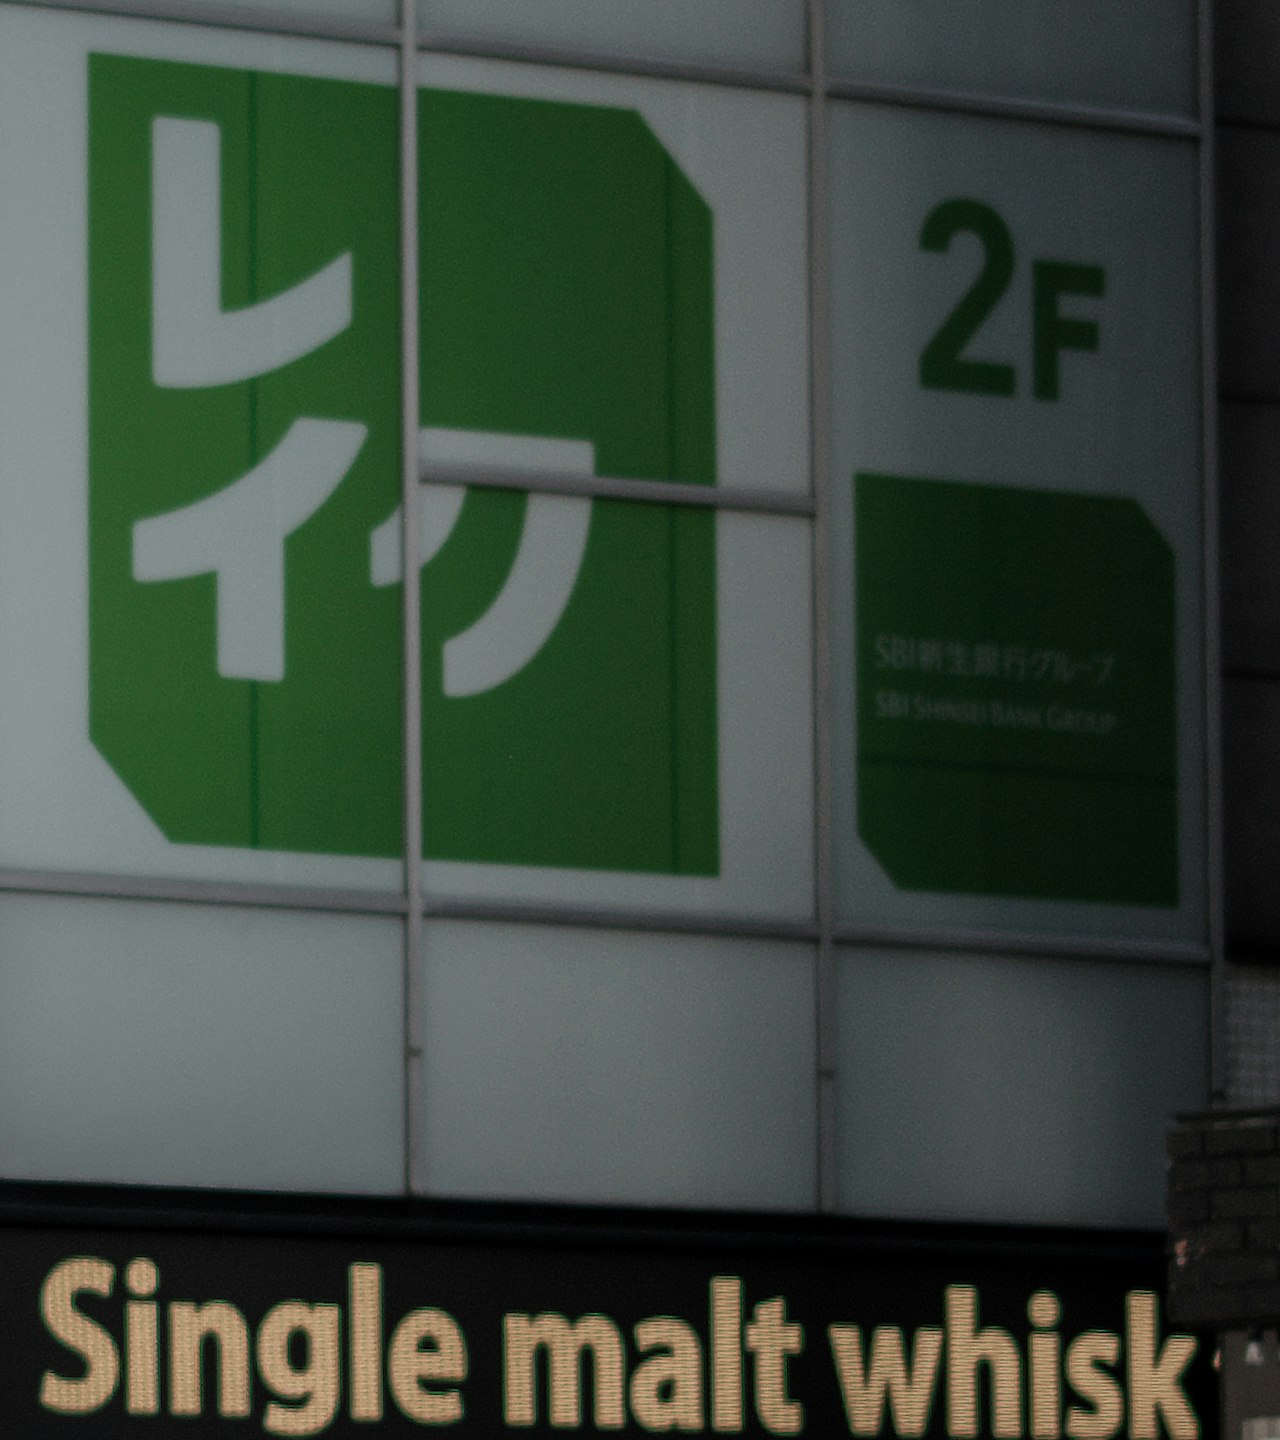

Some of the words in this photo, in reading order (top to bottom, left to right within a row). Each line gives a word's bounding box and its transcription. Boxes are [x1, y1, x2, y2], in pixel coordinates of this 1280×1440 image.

[151, 116, 352, 387] レ
[920, 198, 1106, 402] 2F
[132, 416, 594, 697] イク
[38, 1257, 468, 1436] Single
[503, 1276, 803, 1434] malt
